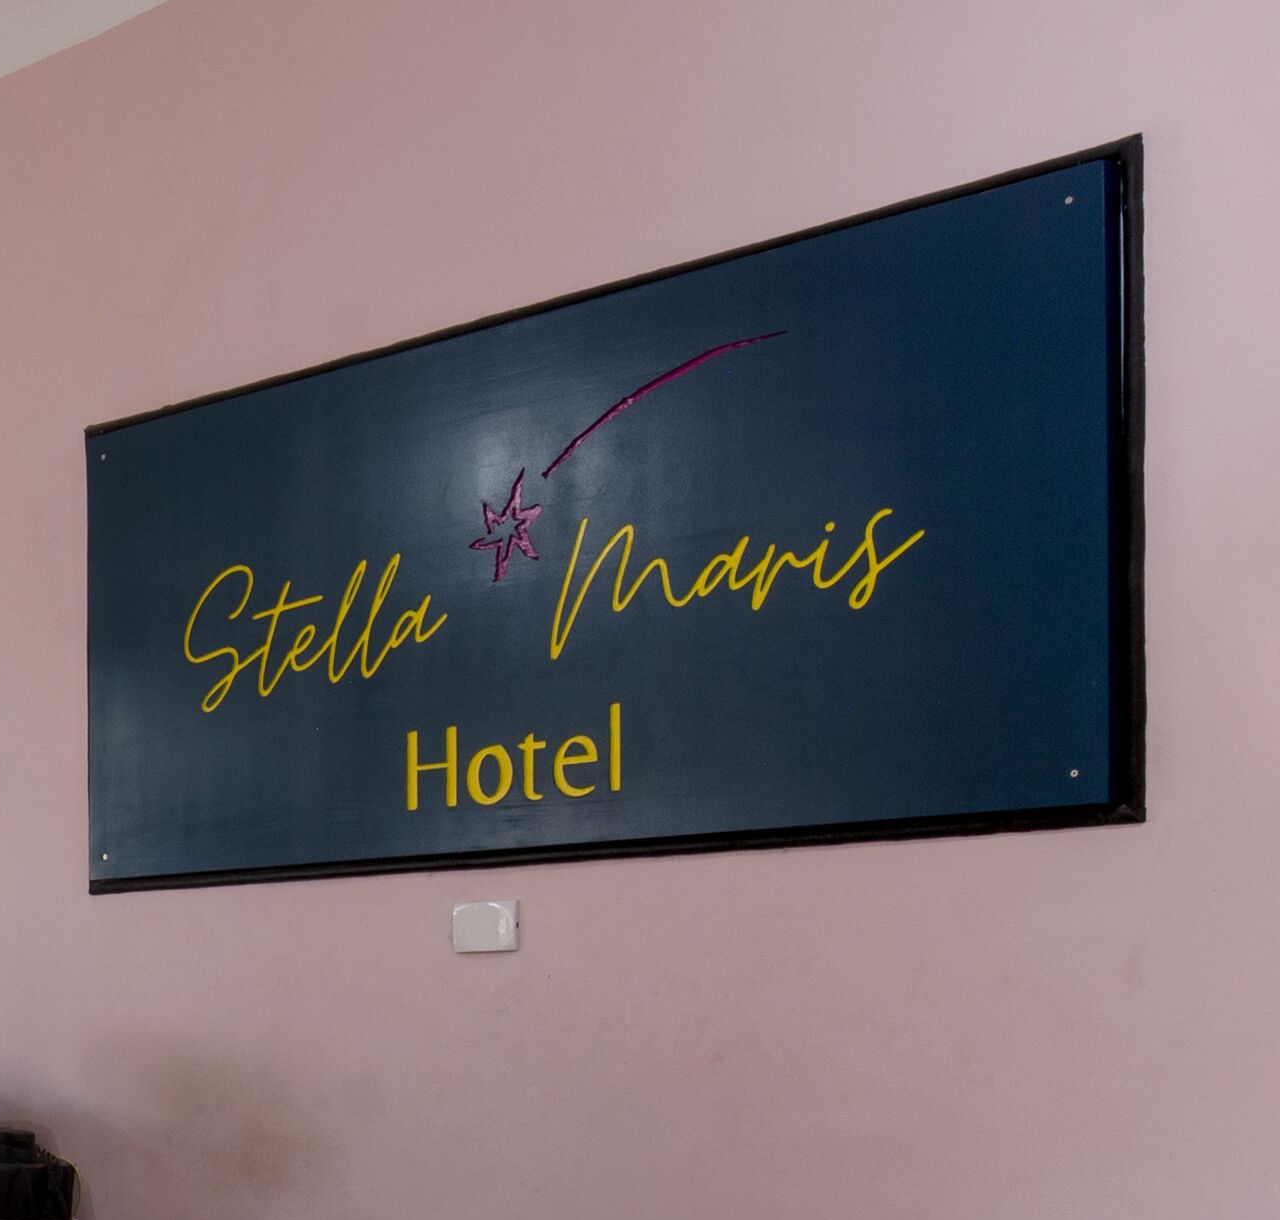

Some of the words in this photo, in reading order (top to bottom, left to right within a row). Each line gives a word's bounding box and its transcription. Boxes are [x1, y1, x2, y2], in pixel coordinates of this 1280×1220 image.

[183, 552, 448, 713] Stella
[549, 507, 926, 660] Maris
[405, 702, 622, 811] Hotel
